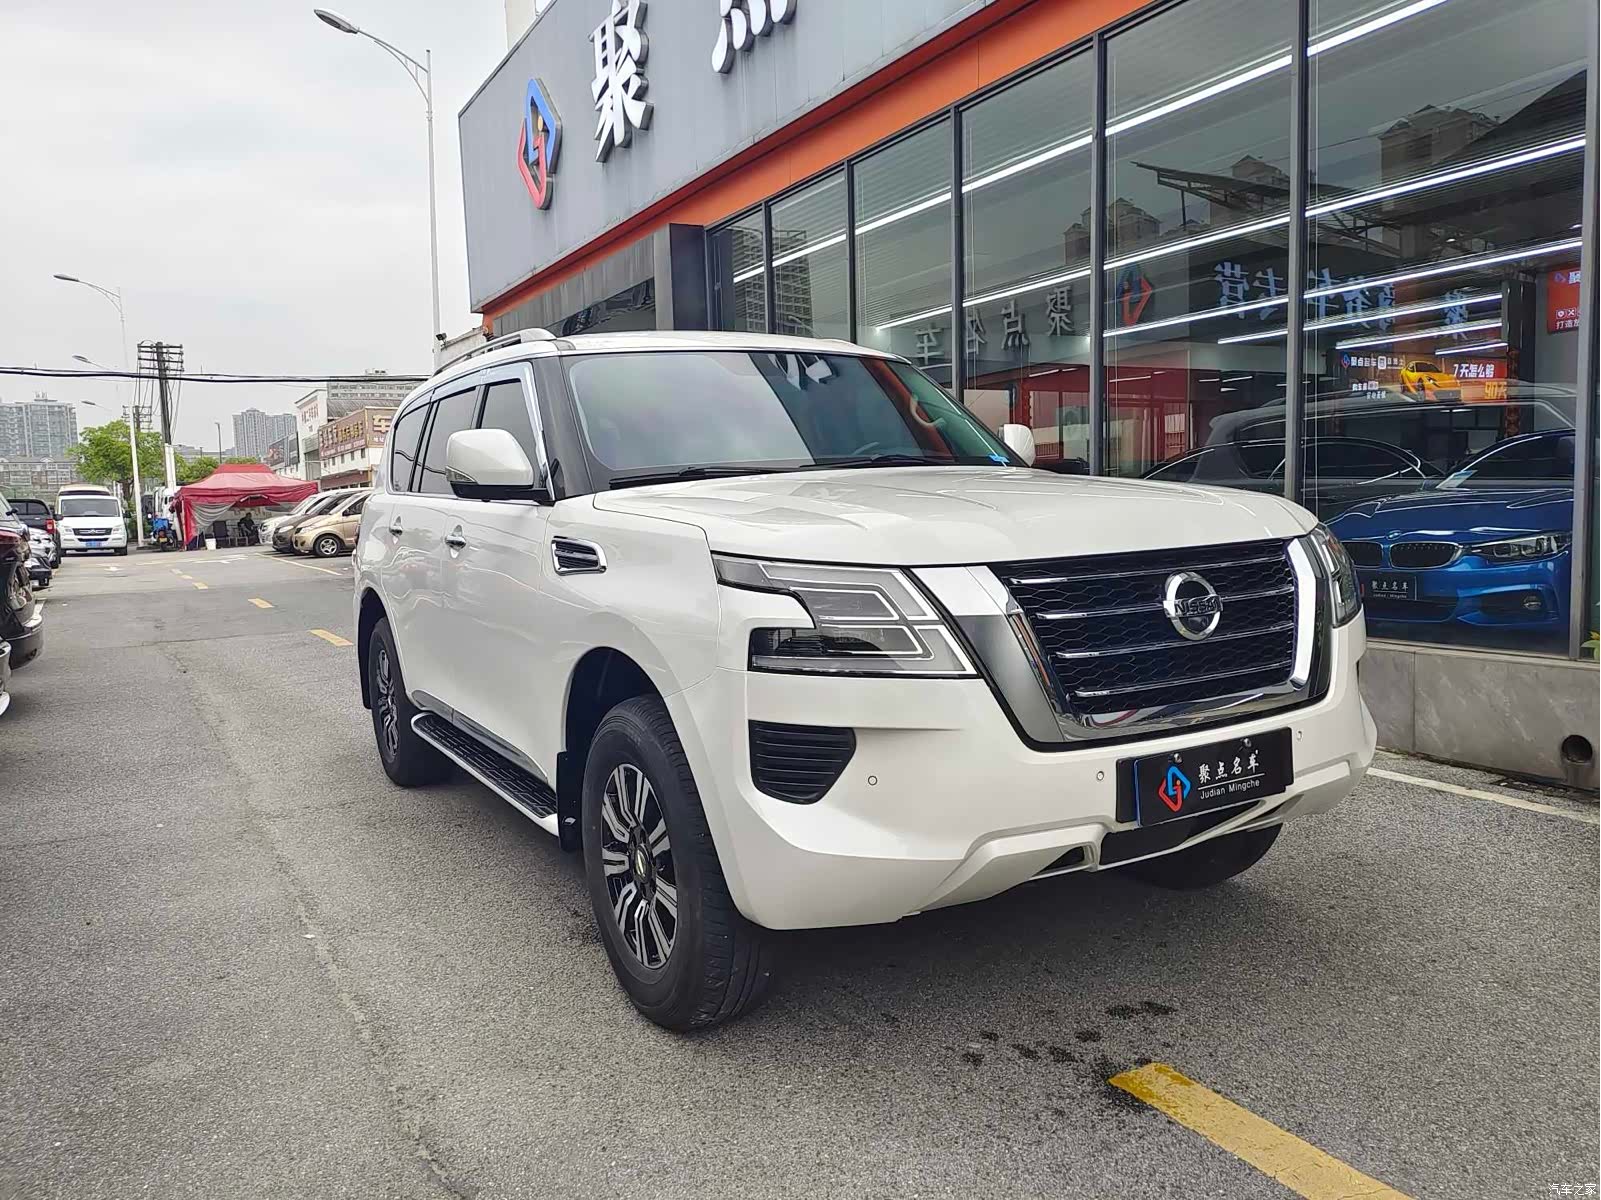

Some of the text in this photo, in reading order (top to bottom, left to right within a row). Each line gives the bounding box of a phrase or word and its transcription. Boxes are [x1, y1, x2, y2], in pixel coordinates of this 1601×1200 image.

[1198, 753, 1260, 784] 聚点名车
[1200, 779, 1260, 800] Judian Mingche
